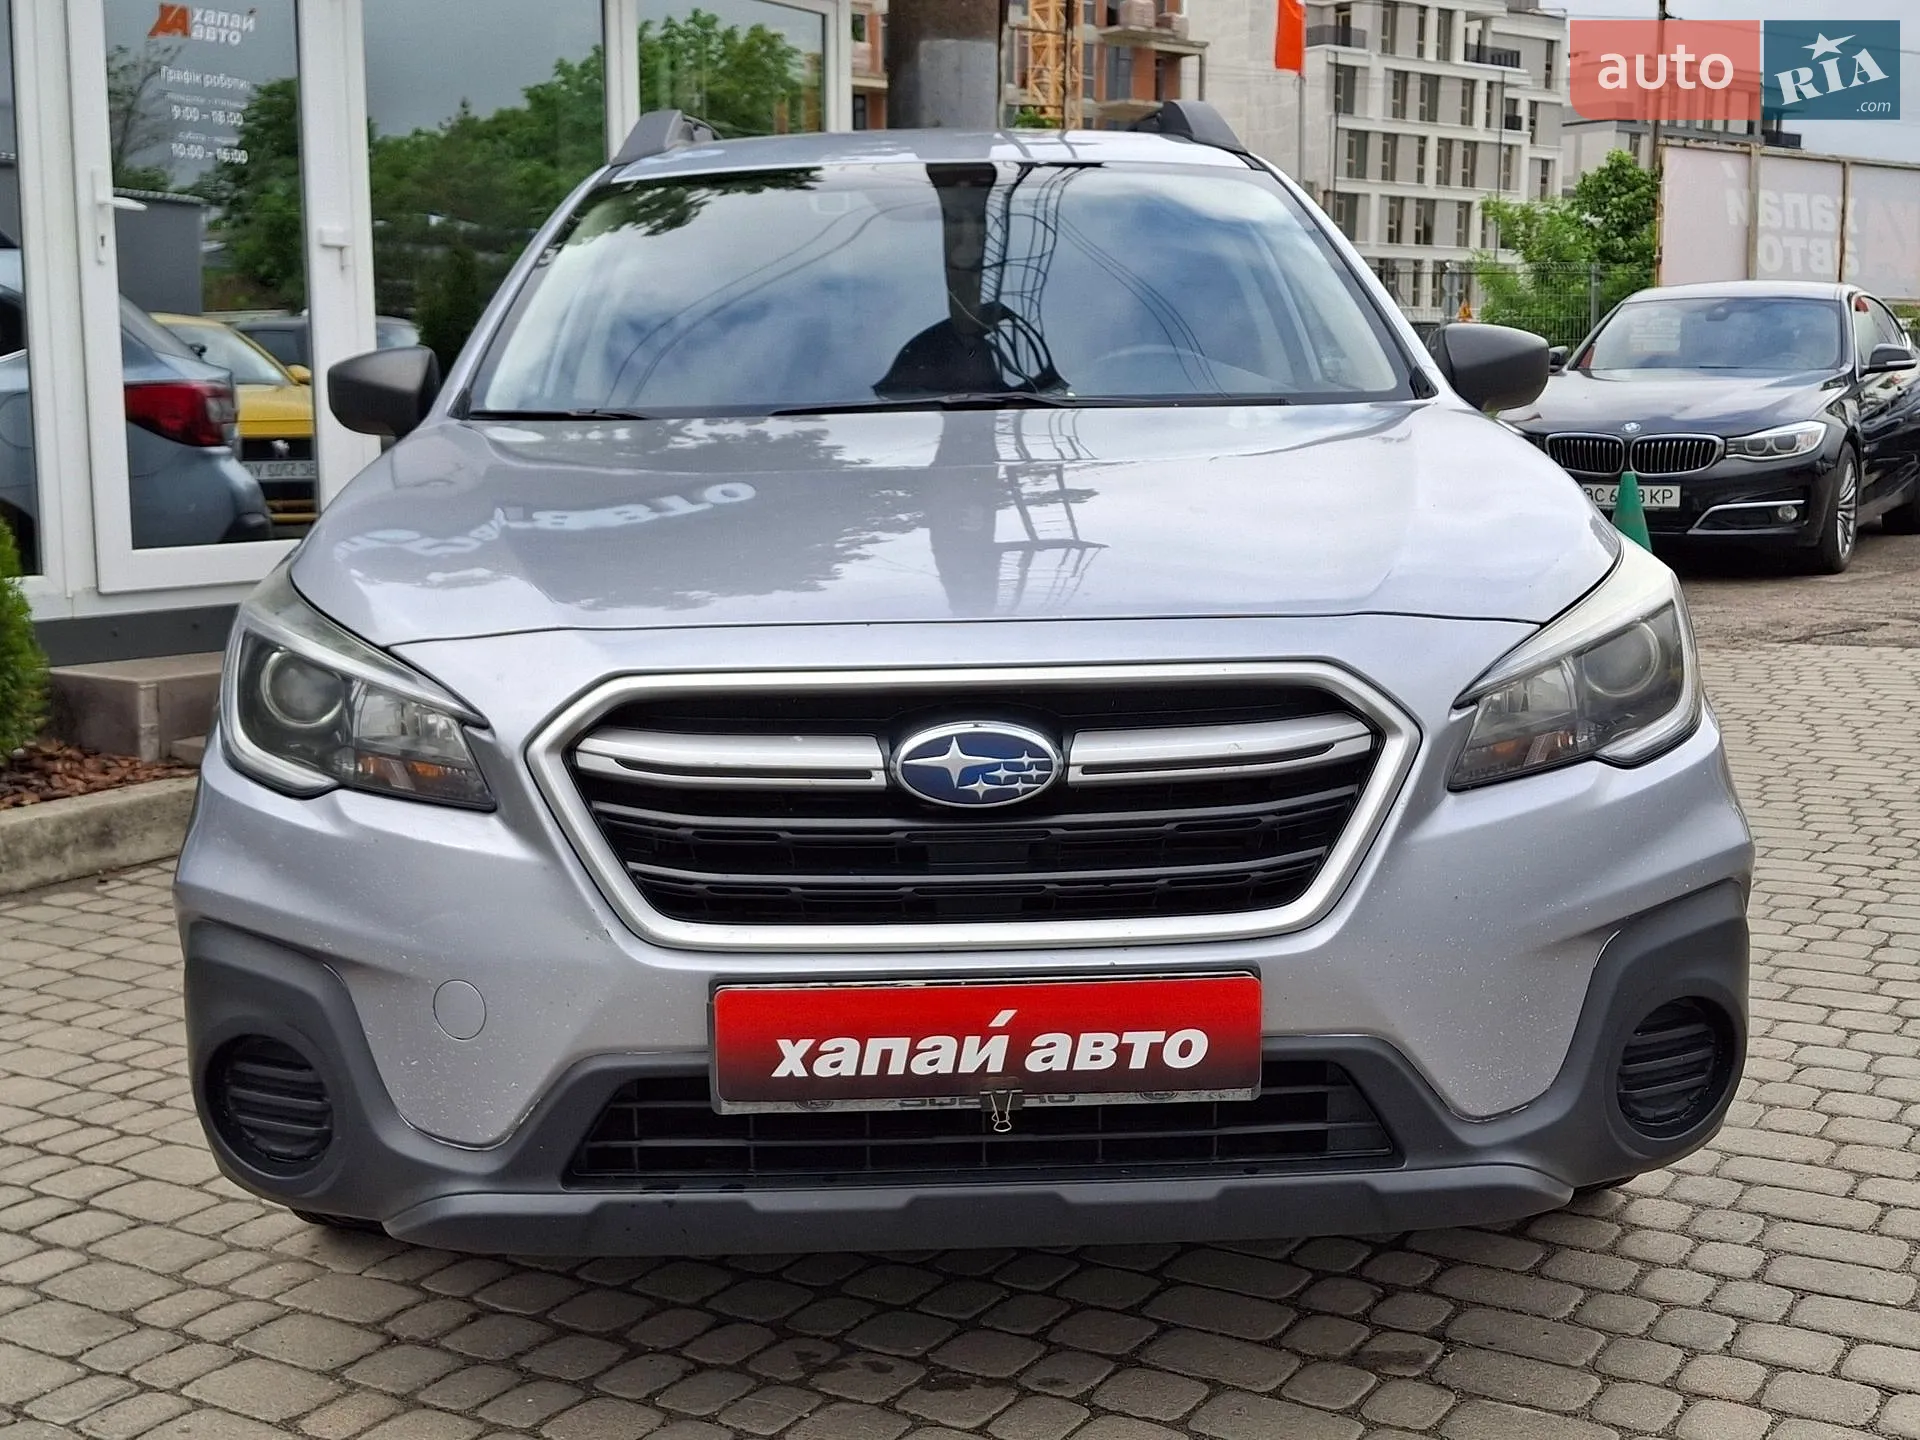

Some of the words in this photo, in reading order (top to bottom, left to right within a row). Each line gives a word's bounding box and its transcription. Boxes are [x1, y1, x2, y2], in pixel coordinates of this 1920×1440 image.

[190, 24, 242, 46] авто
[770, 1009, 1018, 1078] хапай
[1024, 1028, 1209, 1073] авто
